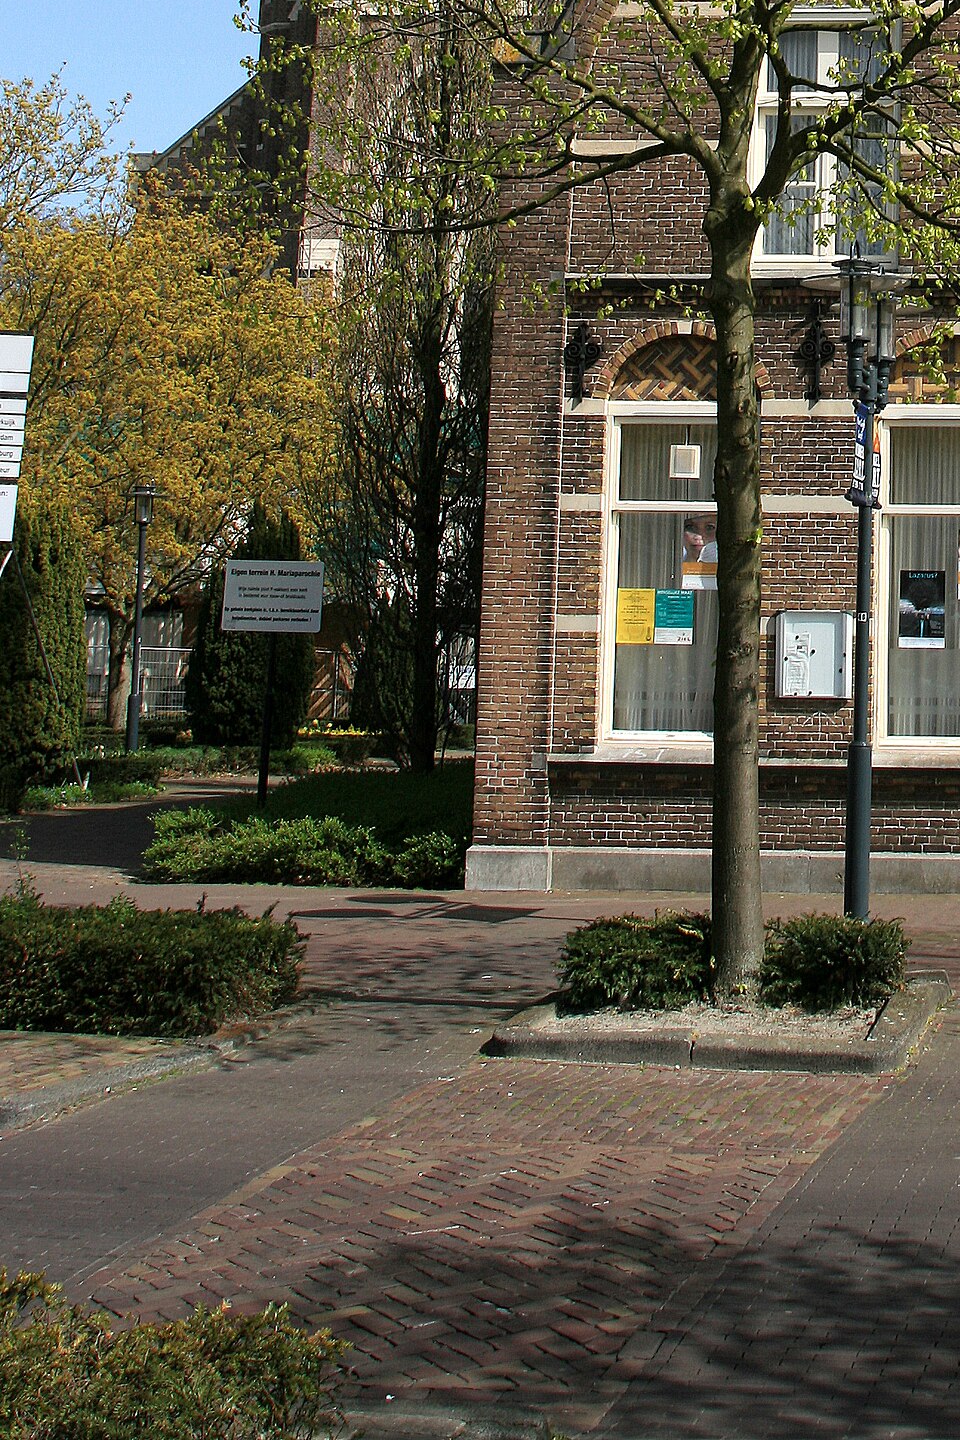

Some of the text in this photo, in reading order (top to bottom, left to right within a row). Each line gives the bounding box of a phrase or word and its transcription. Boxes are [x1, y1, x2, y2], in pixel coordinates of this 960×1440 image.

[0, 418, 16, 427] kwijk
[0, 449, 14, 459] burg
[231, 569, 248, 577] Eigen
[278, 570, 321, 578] Mariaparochie
